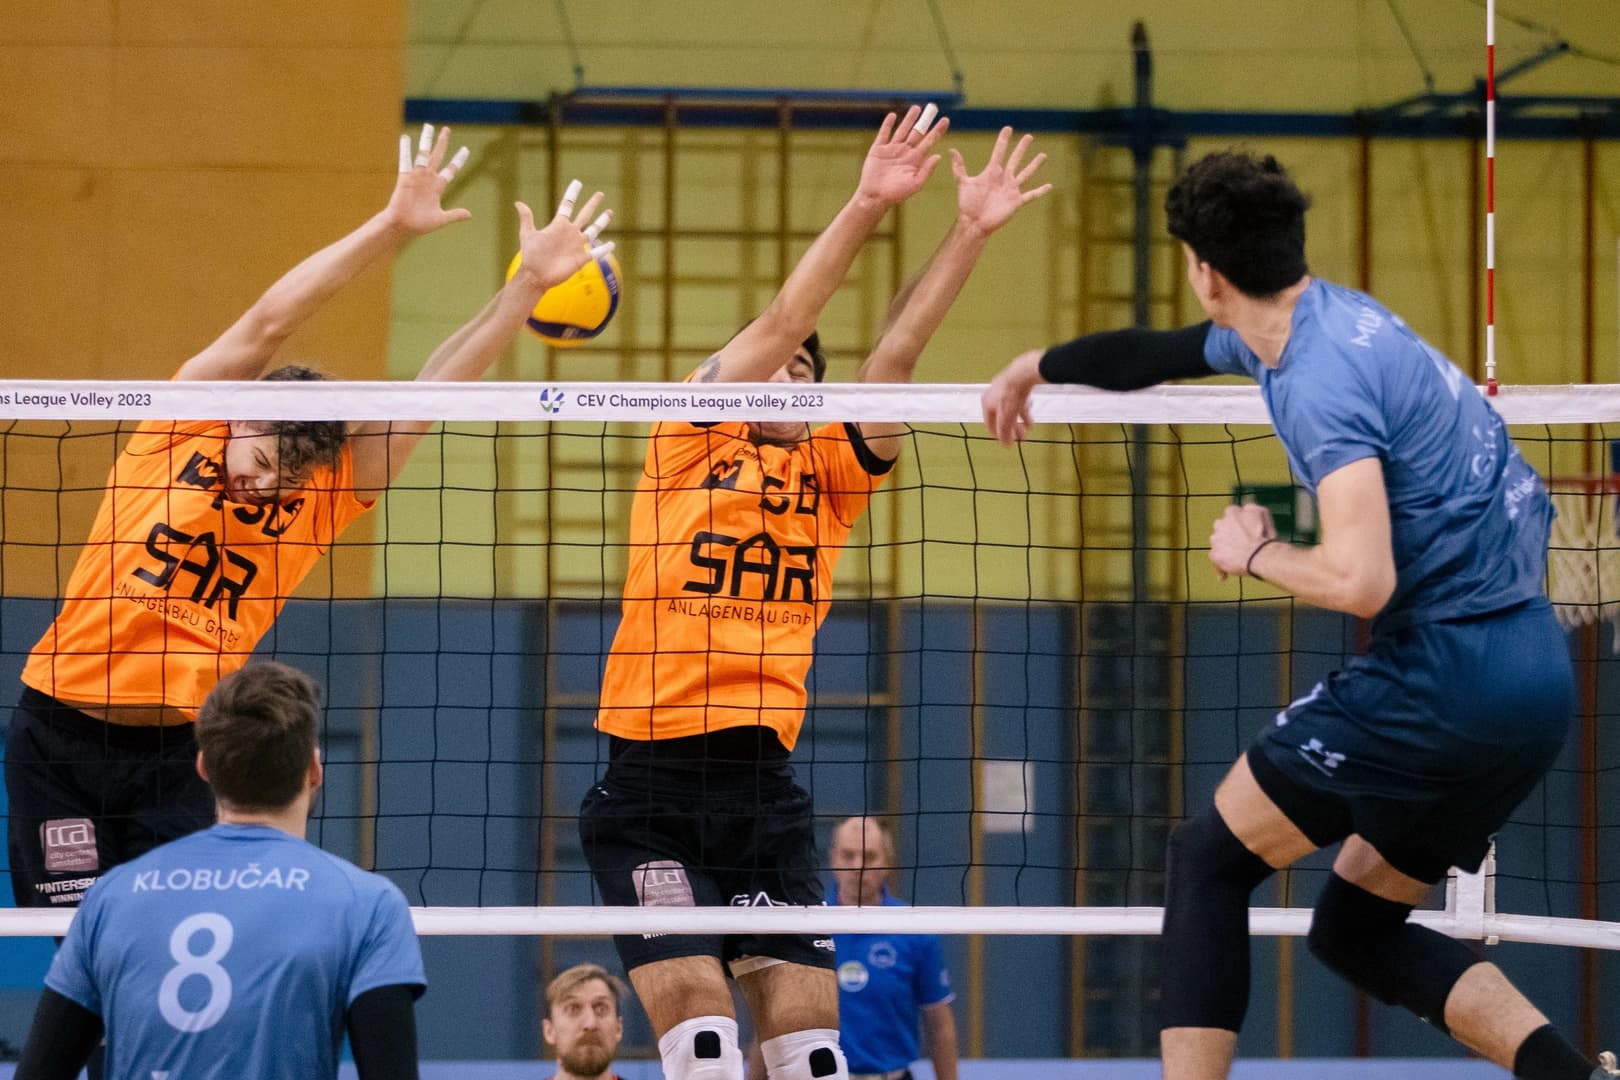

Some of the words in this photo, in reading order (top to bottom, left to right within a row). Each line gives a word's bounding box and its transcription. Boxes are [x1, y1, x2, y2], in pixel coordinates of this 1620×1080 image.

[15, 392, 67, 408] League
[70, 392, 114, 409] Volley
[117, 393, 152, 406] 2023
[576, 394, 606, 407] CEV
[609, 394, 687, 410] Champions
[690, 394, 742, 410] League
[745, 394, 788, 410] Volley
[791, 395, 824, 407] 2023
[131, 522, 258, 622] SAR
[681, 530, 818, 606] SAR
[667, 599, 777, 625] ANLAGENBAU
[132, 862, 311, 893] KLOBUČAR
[157, 911, 235, 1034] 8
